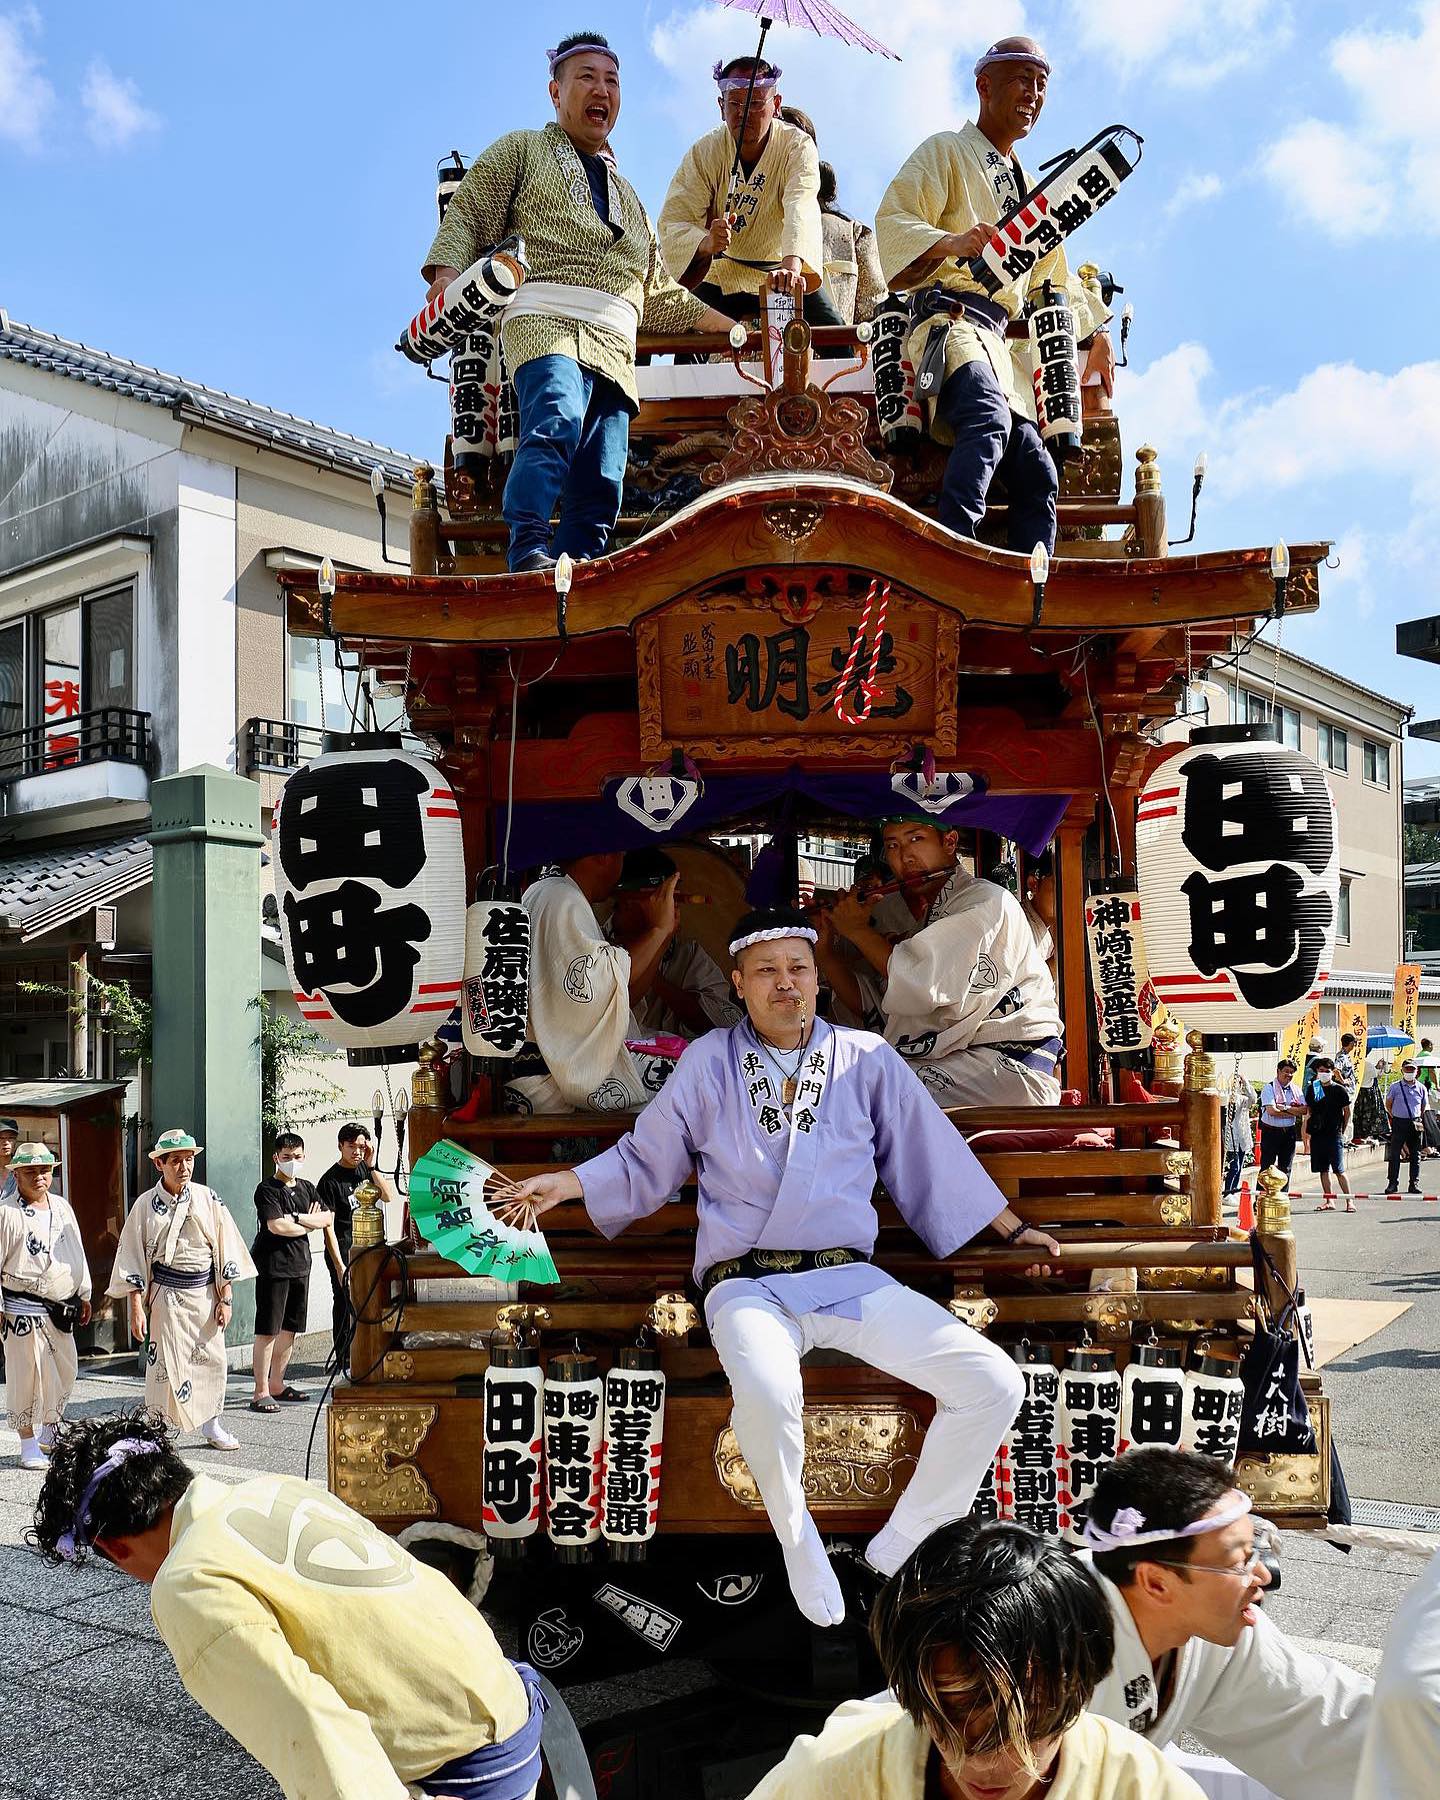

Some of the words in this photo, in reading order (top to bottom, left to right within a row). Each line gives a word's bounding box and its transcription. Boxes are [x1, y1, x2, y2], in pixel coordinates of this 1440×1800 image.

[279, 758, 432, 1028] 田町
[1178, 752, 1334, 1011] 田町
[742, 1052, 782, 1135] 東門會
[795, 1050, 826, 1134] 東門會
[484, 1377, 538, 1525] 田町
